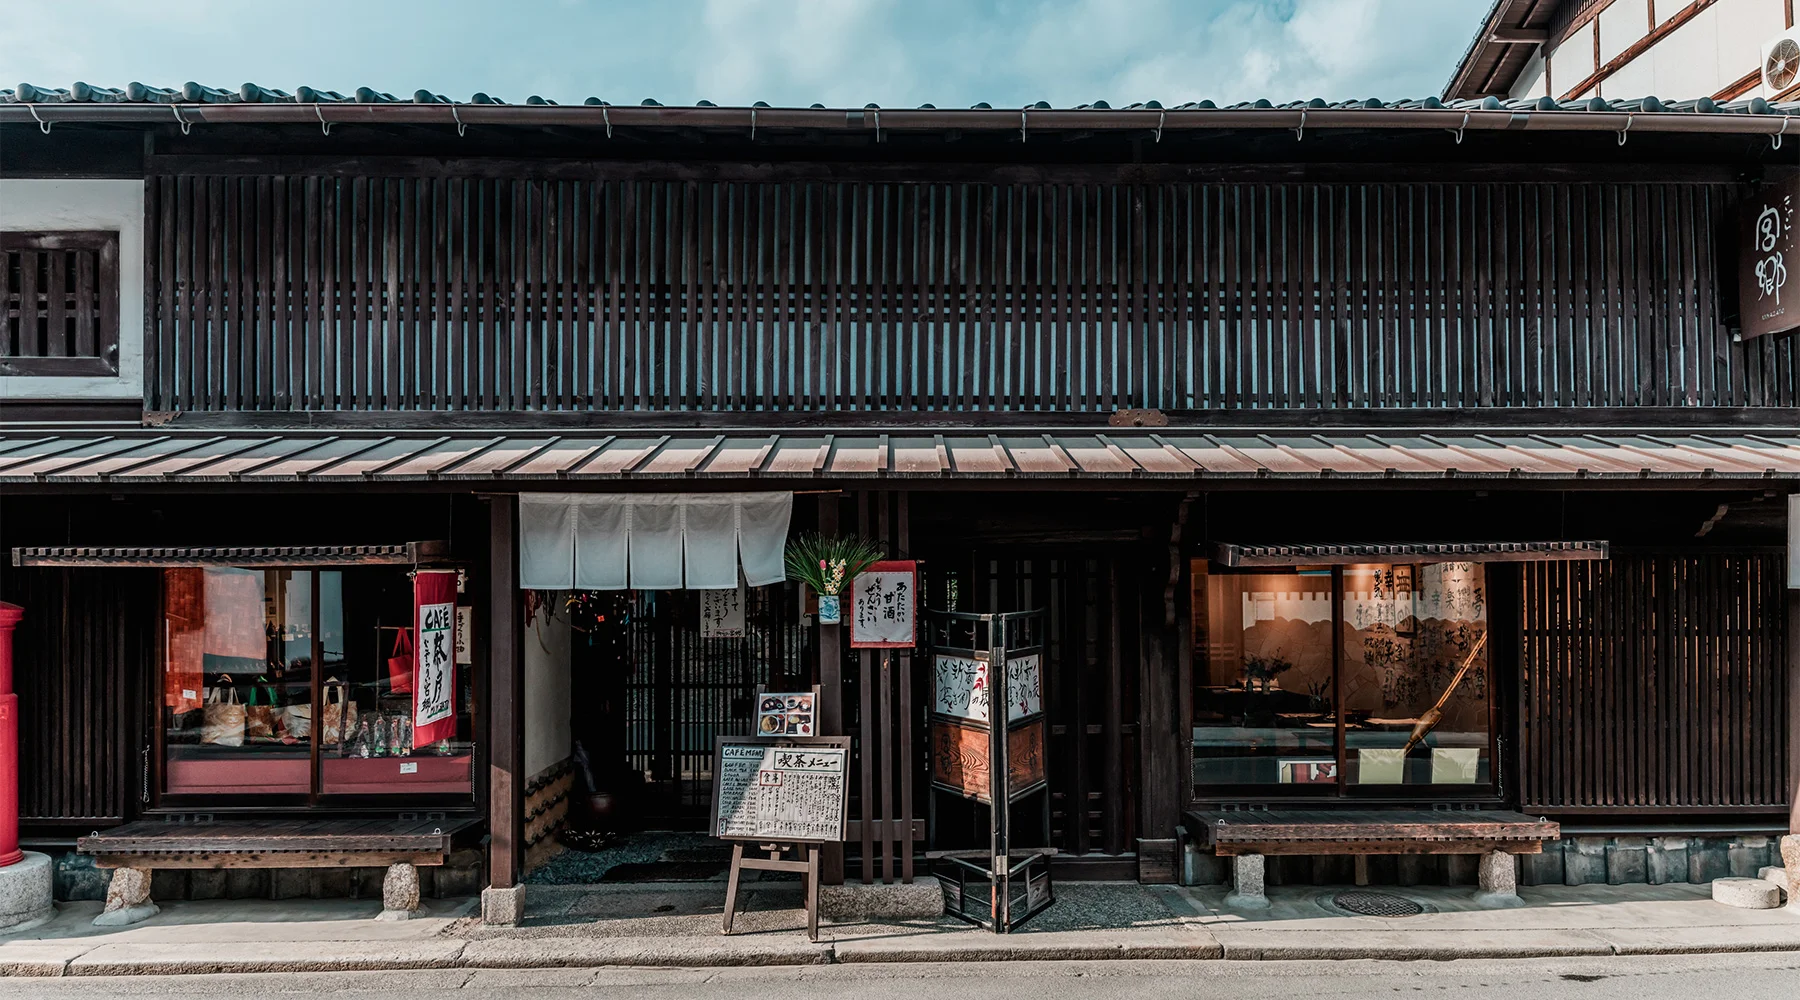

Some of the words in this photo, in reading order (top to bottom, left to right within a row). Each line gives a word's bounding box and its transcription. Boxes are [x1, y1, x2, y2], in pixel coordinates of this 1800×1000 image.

[882, 591, 896, 620] 甘酒
[896, 581, 908, 623] あたたかい
[424, 606, 450, 629] CAFÉ
[724, 747, 745, 757] CAFÉ
[777, 752, 839, 768] 喫茶メニュー
[763, 772, 781, 784] 食事
